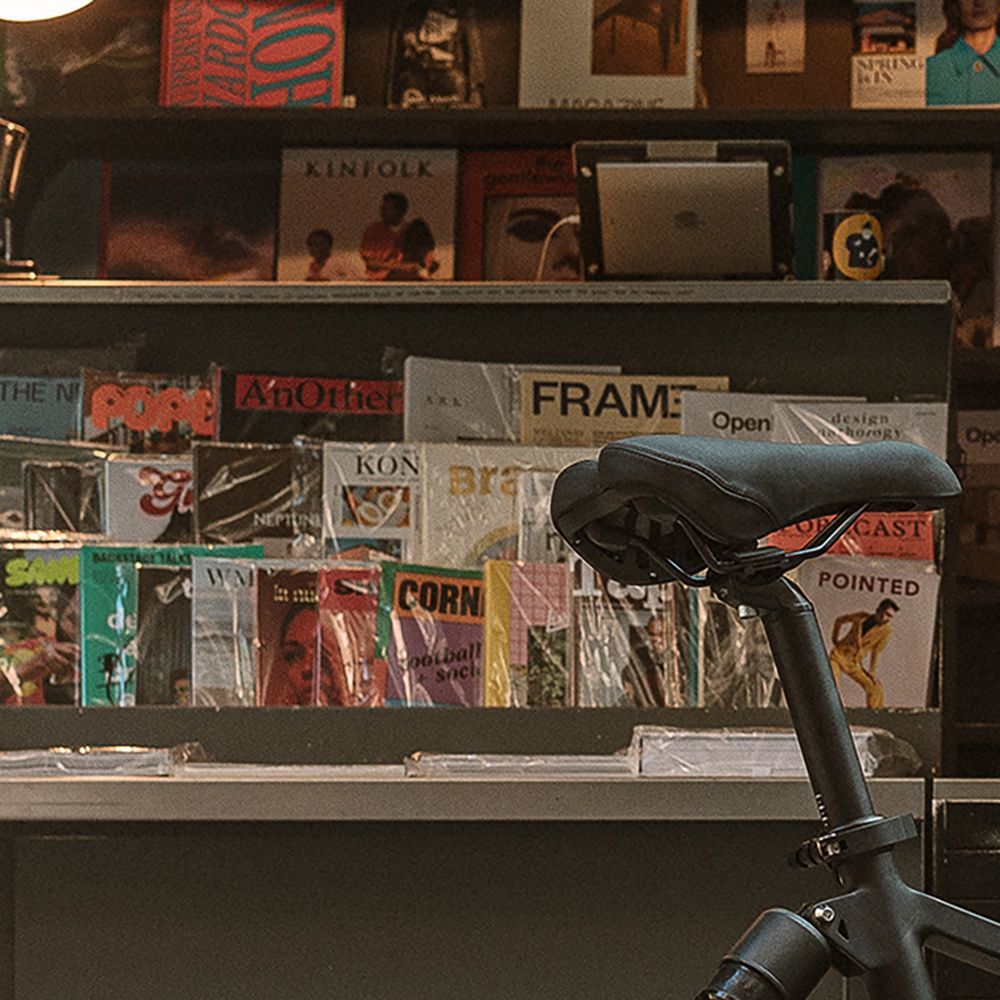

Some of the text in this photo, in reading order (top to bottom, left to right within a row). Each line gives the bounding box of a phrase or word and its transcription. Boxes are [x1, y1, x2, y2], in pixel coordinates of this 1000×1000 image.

[305, 160, 434, 178] KINFOLK
[0, 382, 80, 403] THE N
[241, 379, 401, 411] AnOther
[712, 410, 772, 435] Open
[831, 410, 890, 427] design
[818, 571, 920, 597] POINTED
[399, 579, 485, 618] CORN
[408, 643, 481, 668] ootball
